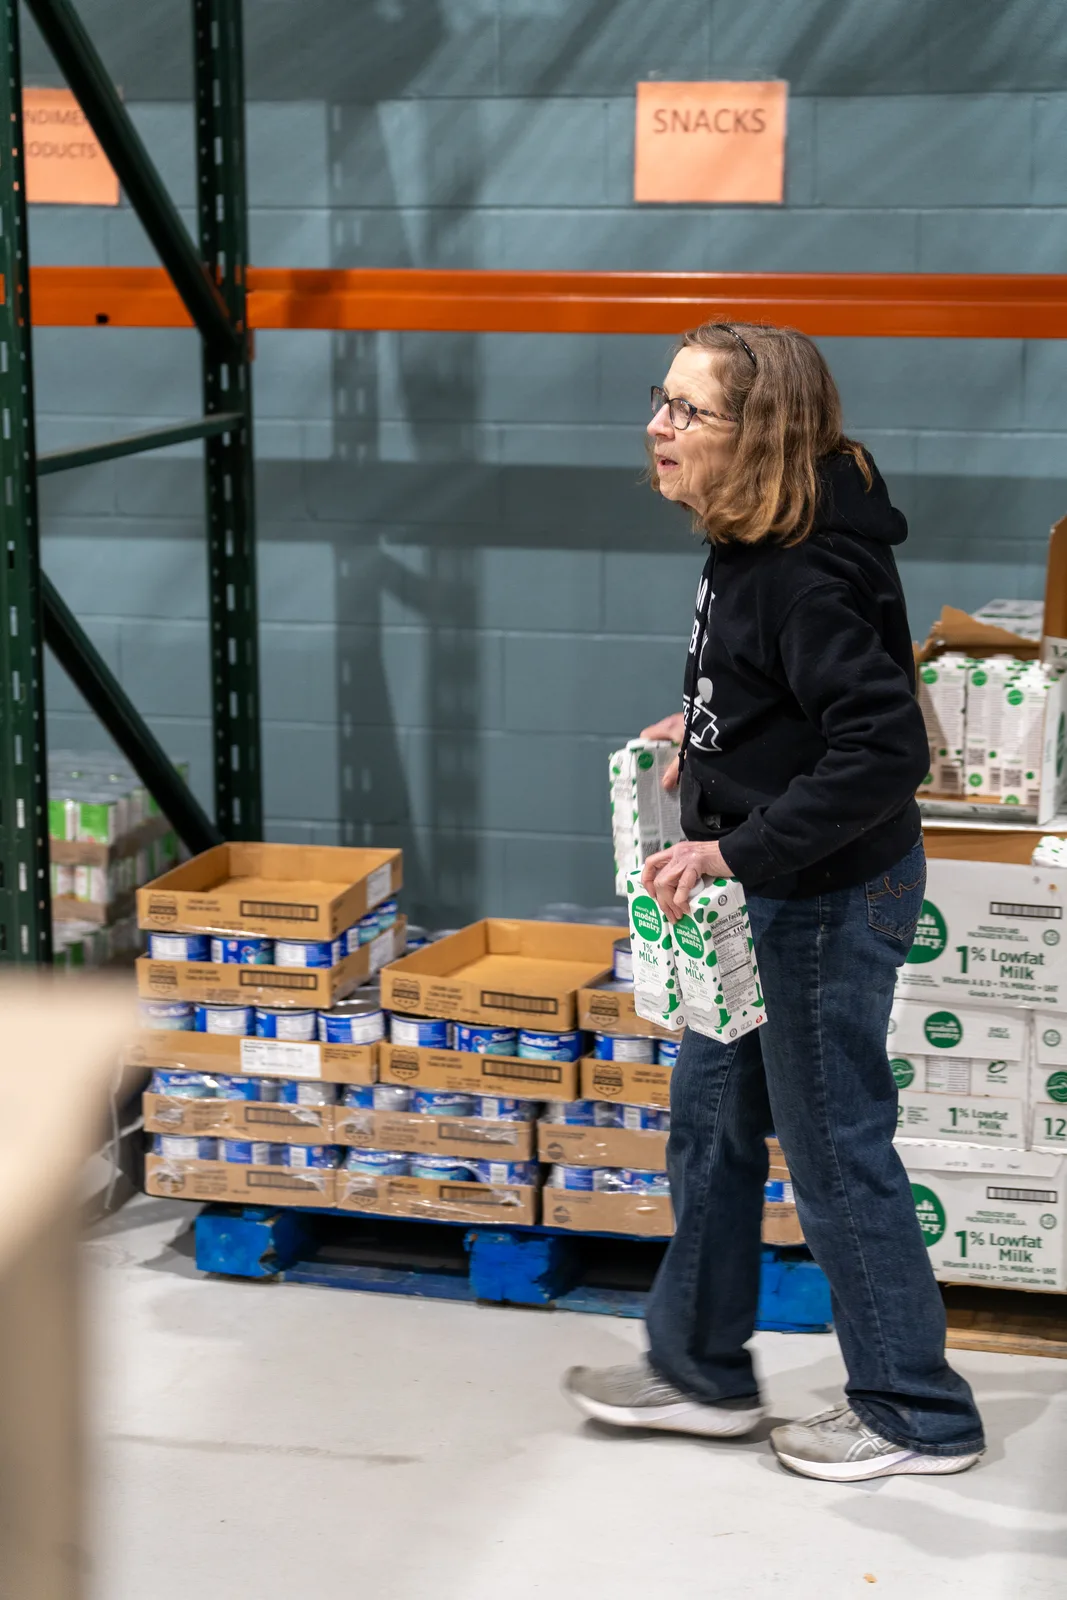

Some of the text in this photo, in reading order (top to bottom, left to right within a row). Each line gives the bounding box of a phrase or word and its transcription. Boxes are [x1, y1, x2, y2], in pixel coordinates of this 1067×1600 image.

[653, 107, 766, 134] SNACKS
[27, 141, 97, 159] ODUCTS
[634, 910, 659, 924] modern
[638, 919, 660, 933] pantry
[916, 926, 940, 936] ern
[676, 928, 701, 943] modern
[643, 942, 653, 954] 1%
[681, 936, 702, 951] pantry
[639, 950, 659, 966] MILK
[991, 948, 1045, 965] Lowfat
[688, 959, 699, 971] 1%
[999, 964, 1035, 980] Milk
[685, 967, 706, 983] MILK
[972, 1109, 1009, 1121] Lowfat
[978, 1120, 1002, 1130] Milk
[1044, 1117, 1067, 1137] 12
[989, 1232, 1043, 1249] Lowfat
[999, 1249, 1033, 1263] Milk
